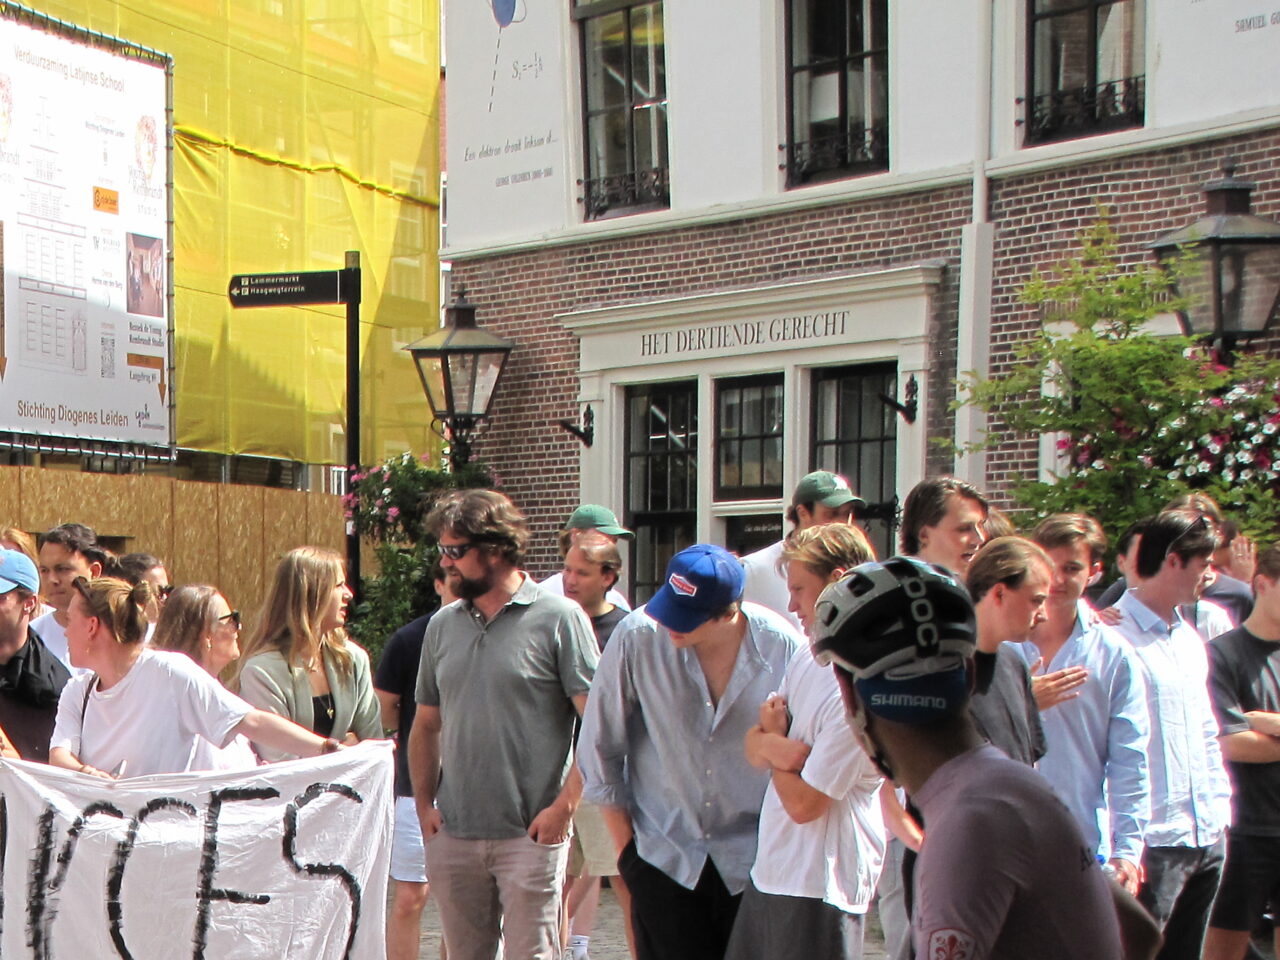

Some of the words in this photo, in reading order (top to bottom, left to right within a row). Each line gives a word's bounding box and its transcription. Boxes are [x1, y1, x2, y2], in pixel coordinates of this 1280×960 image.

[1235, 15, 1266, 33] SAMUEL
[15, 46, 68, 80] Verduurzaming
[70, 63, 99, 87] Latijnse
[100, 72, 125, 94] School
[250, 276, 300, 285] Lammermarkt
[250, 286, 305, 295] Haagwegterrein
[640, 331, 672, 356] HET
[676, 321, 766, 353] DERTIENDE
[769, 310, 850, 343] GERECHT
[17, 400, 55, 424] Stichting
[58, 405, 98, 426] Diogenes
[100, 409, 129, 427] Leiden
[871, 693, 947, 710] SHIMANO
